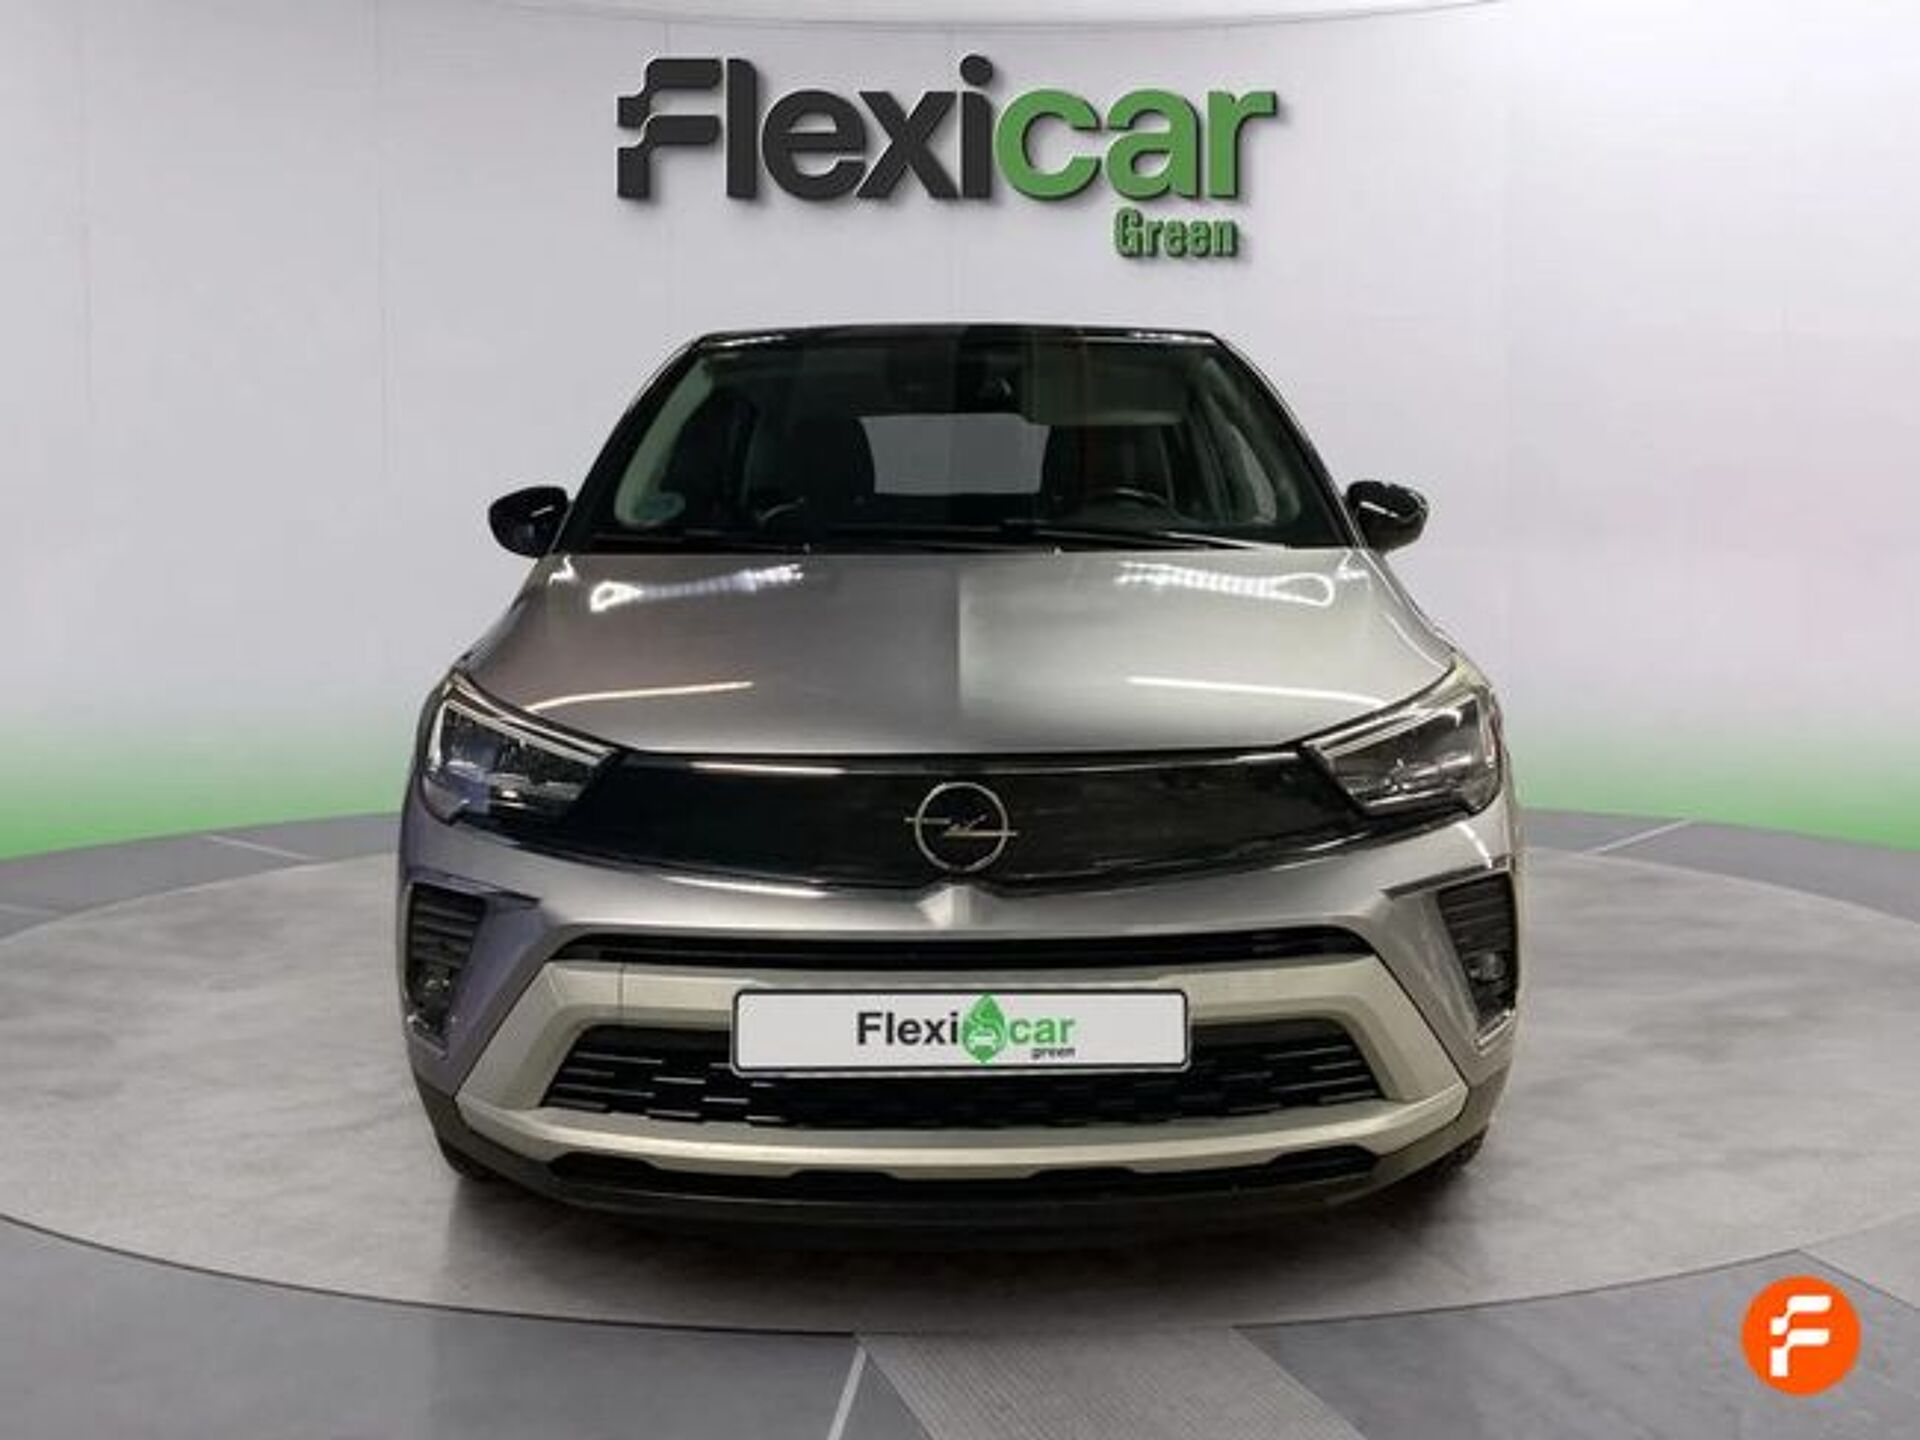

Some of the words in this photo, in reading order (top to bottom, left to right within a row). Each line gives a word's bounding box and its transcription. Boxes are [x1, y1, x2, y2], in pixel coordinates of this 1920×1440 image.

[616, 54, 1277, 201] Flexicar
[1114, 207, 1239, 258] Green
[1031, 1046, 1076, 1060] green
